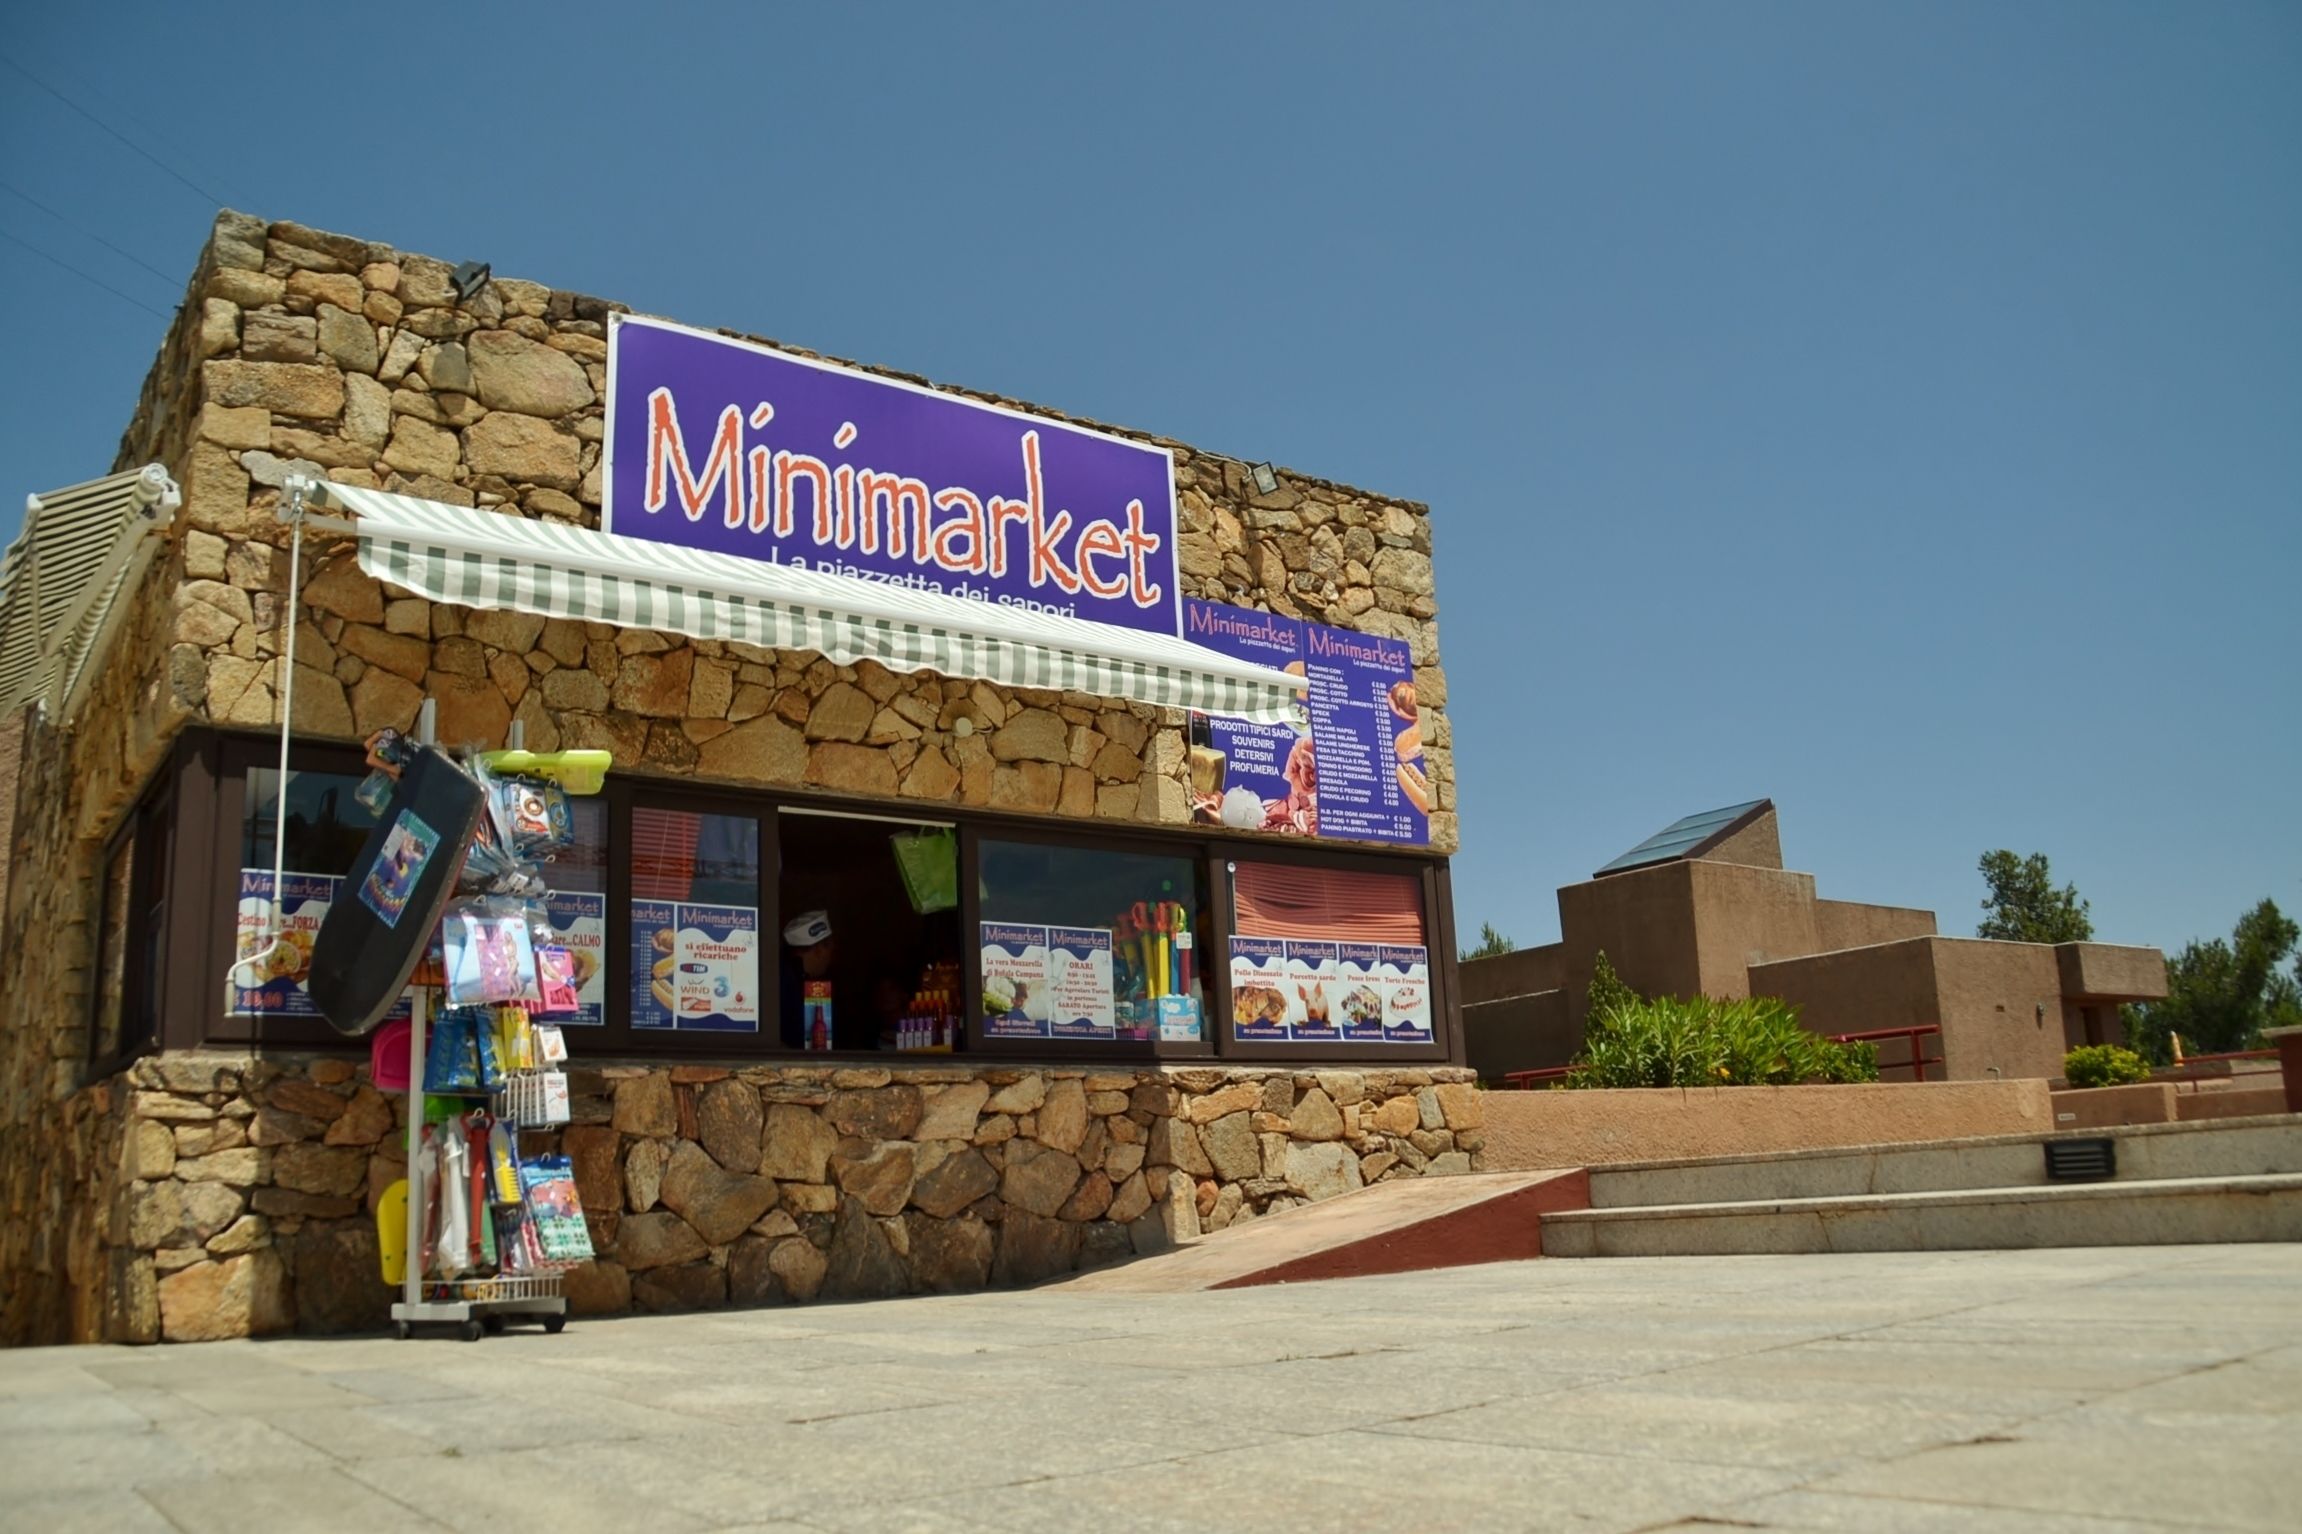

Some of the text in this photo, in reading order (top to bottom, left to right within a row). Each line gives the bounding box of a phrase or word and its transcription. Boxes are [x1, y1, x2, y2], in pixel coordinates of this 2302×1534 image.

[644, 386, 1162, 607] Minimarket
[772, 546, 807, 569] La
[951, 582, 989, 603] dei
[1190, 604, 1295, 646] Minimarket
[1308, 627, 1406, 667] Minimarket
[1308, 672, 1343, 682] MORTADELLA
[1311, 702, 1339, 710] PANCETTA
[1210, 720, 1249, 733] PRODOTTI
[1250, 725, 1271, 736] TIPICI
[1272, 728, 1293, 739] SARDI
[1232, 735, 1275, 750] SOUVENIRS
[1338, 743, 1370, 751] UNGHERESE
[1235, 749, 1273, 762] DETERSIVI
[1230, 761, 1279, 776] PROFUMERIA
[242, 874, 329, 896] Minmarket
[682, 908, 752, 925] Minimarket
[986, 926, 1043, 942] Minimarket
[1052, 930, 1107, 945] Minimarket
[1233, 940, 1281, 953] Minimarket
[1289, 943, 1335, 956] Minimarket
[1382, 948, 1424, 960] Minimarket
[694, 952, 738, 960] ricariche
